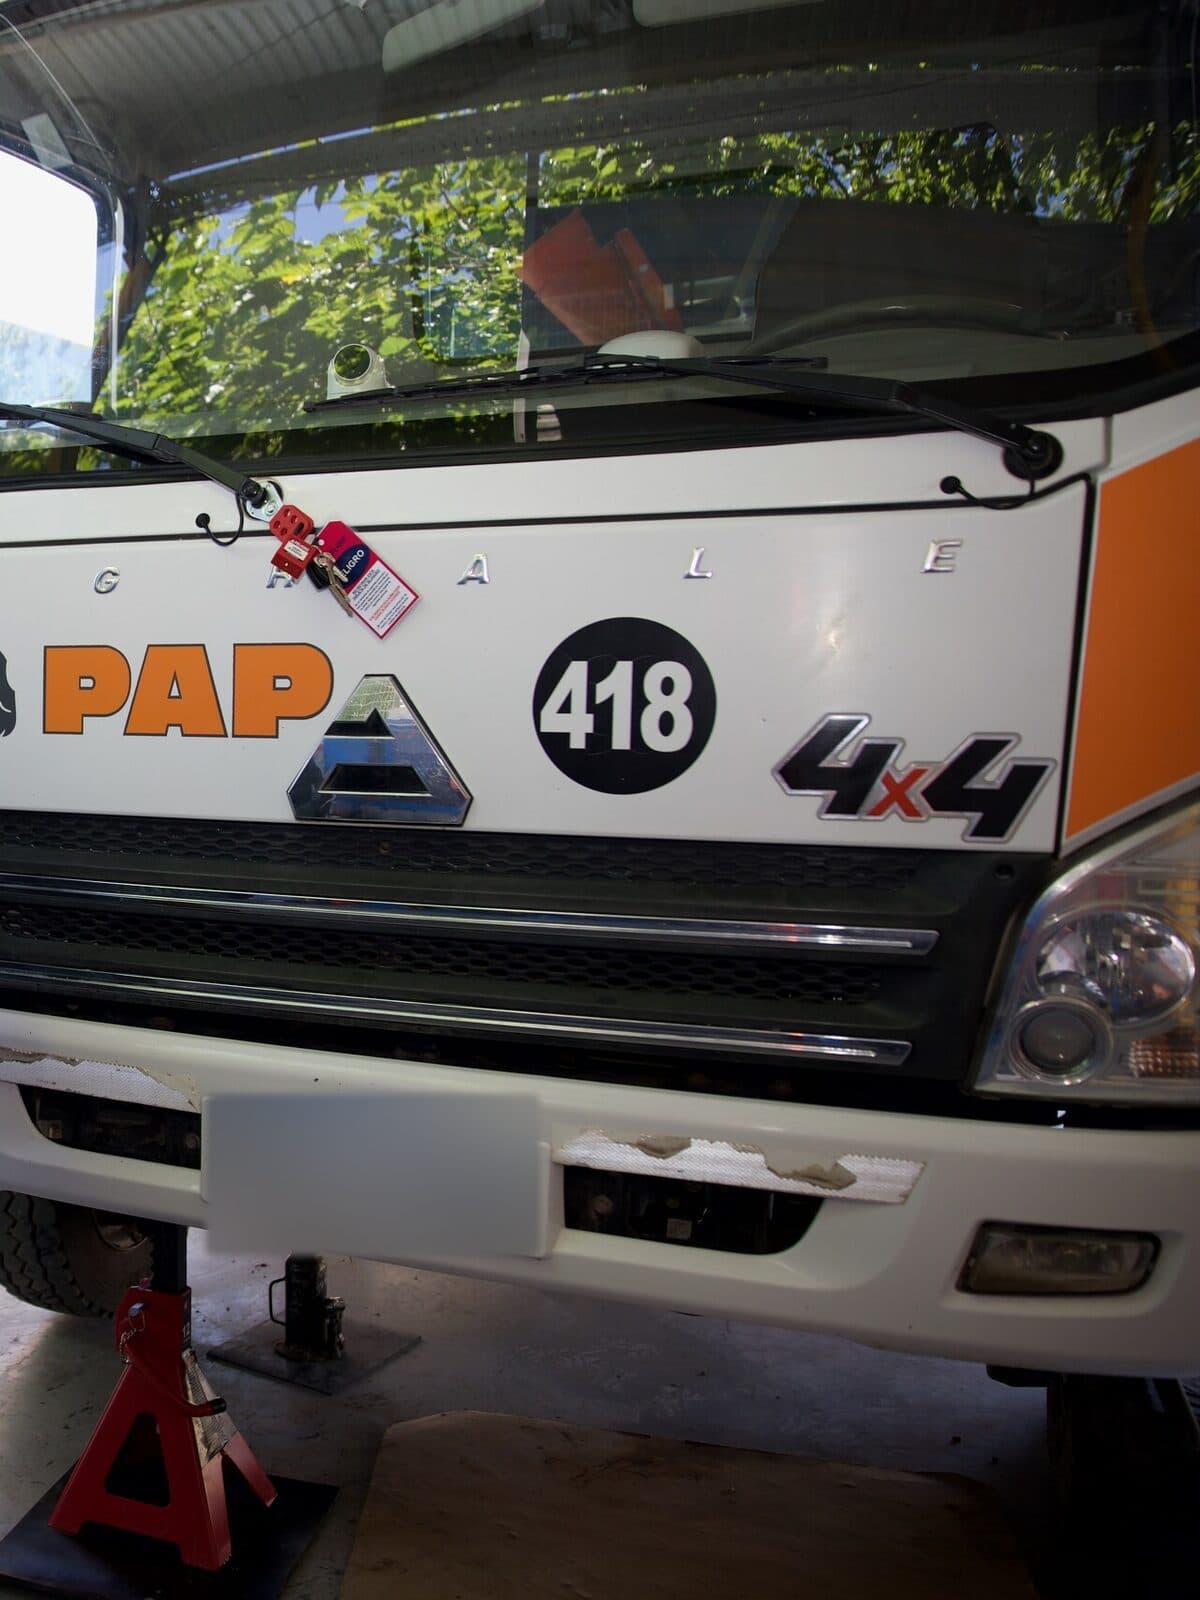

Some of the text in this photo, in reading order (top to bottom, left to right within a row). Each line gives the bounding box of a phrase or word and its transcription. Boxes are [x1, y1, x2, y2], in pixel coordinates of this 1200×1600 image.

[43, 642, 334, 739] PAP
[540, 660, 694, 753] 418
[771, 713, 1057, 843] 4x4
